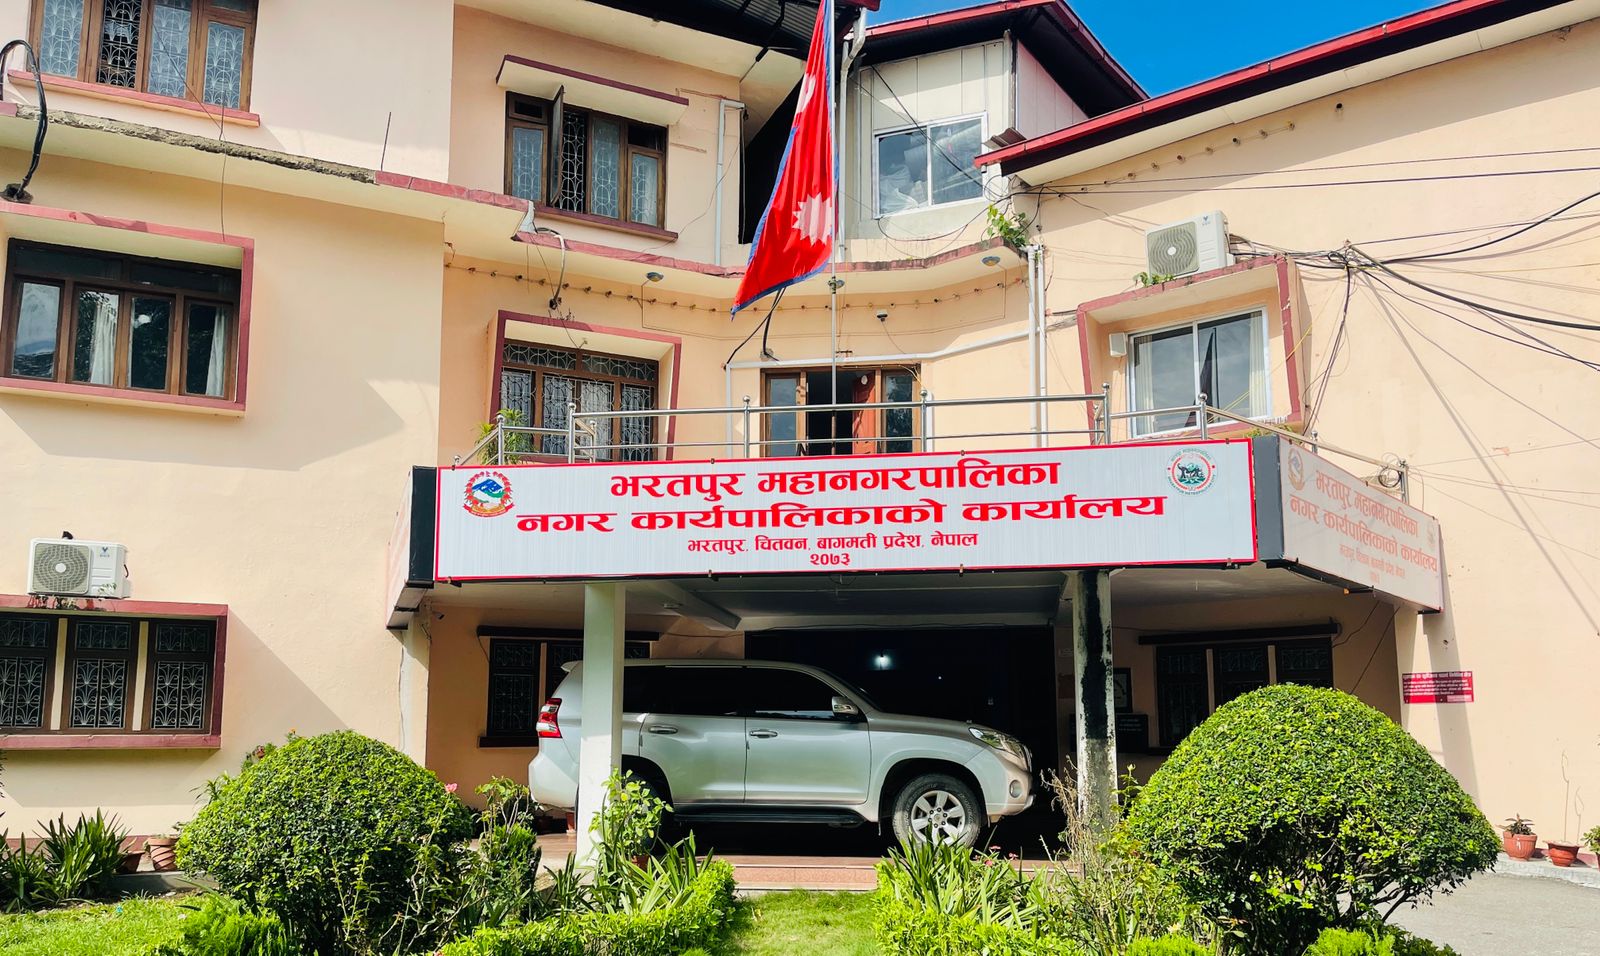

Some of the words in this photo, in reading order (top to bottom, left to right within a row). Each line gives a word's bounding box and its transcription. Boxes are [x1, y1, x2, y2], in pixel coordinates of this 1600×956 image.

[610, 472, 746, 502] भरतपुर
[757, 456, 1061, 495] महानगरपालिका
[516, 512, 618, 532] नगर
[631, 498, 947, 531] कार्यपालिकाको
[962, 494, 1168, 522] कार्यालय
[816, 533, 877, 550] बागमती
[930, 530, 978, 547] नेपाल
[809, 553, 850, 566] २०७३
